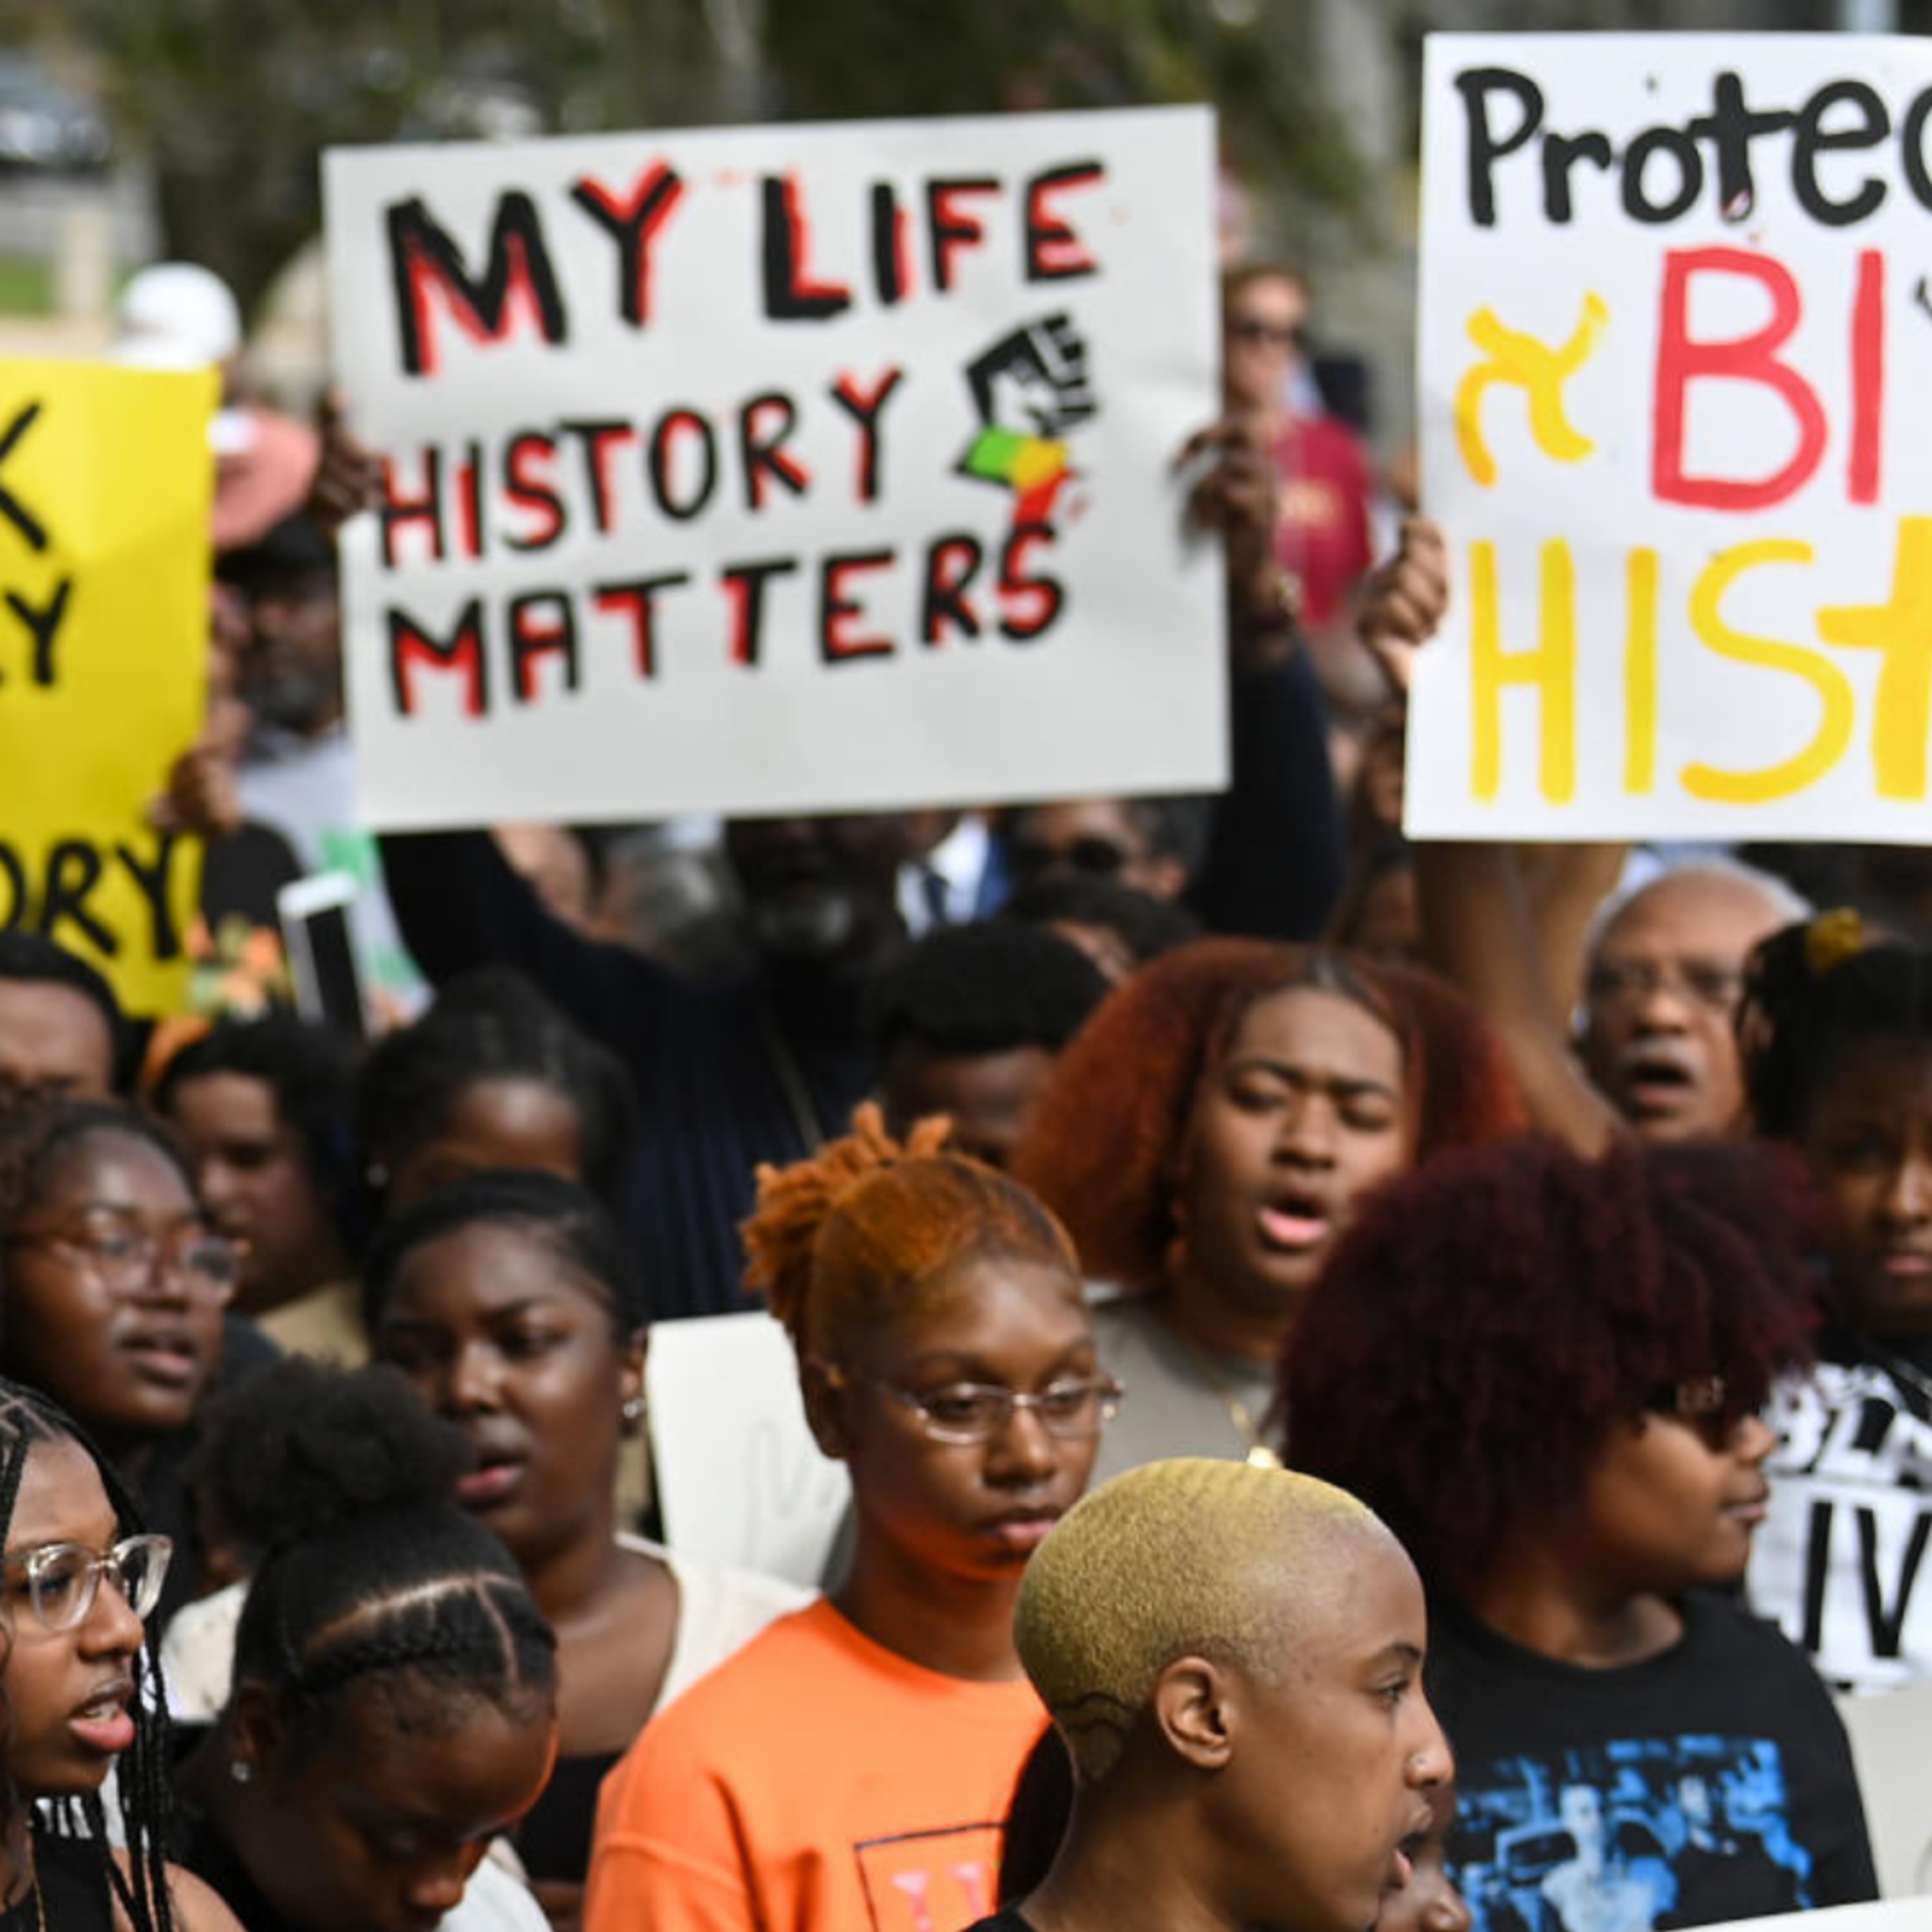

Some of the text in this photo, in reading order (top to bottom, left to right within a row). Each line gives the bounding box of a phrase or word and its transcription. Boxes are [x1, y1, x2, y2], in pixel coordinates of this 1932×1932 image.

[388, 159, 1103, 377] MY LIFE
[381, 368, 906, 568] HISTORY
[388, 523, 1066, 720] MATTERS
